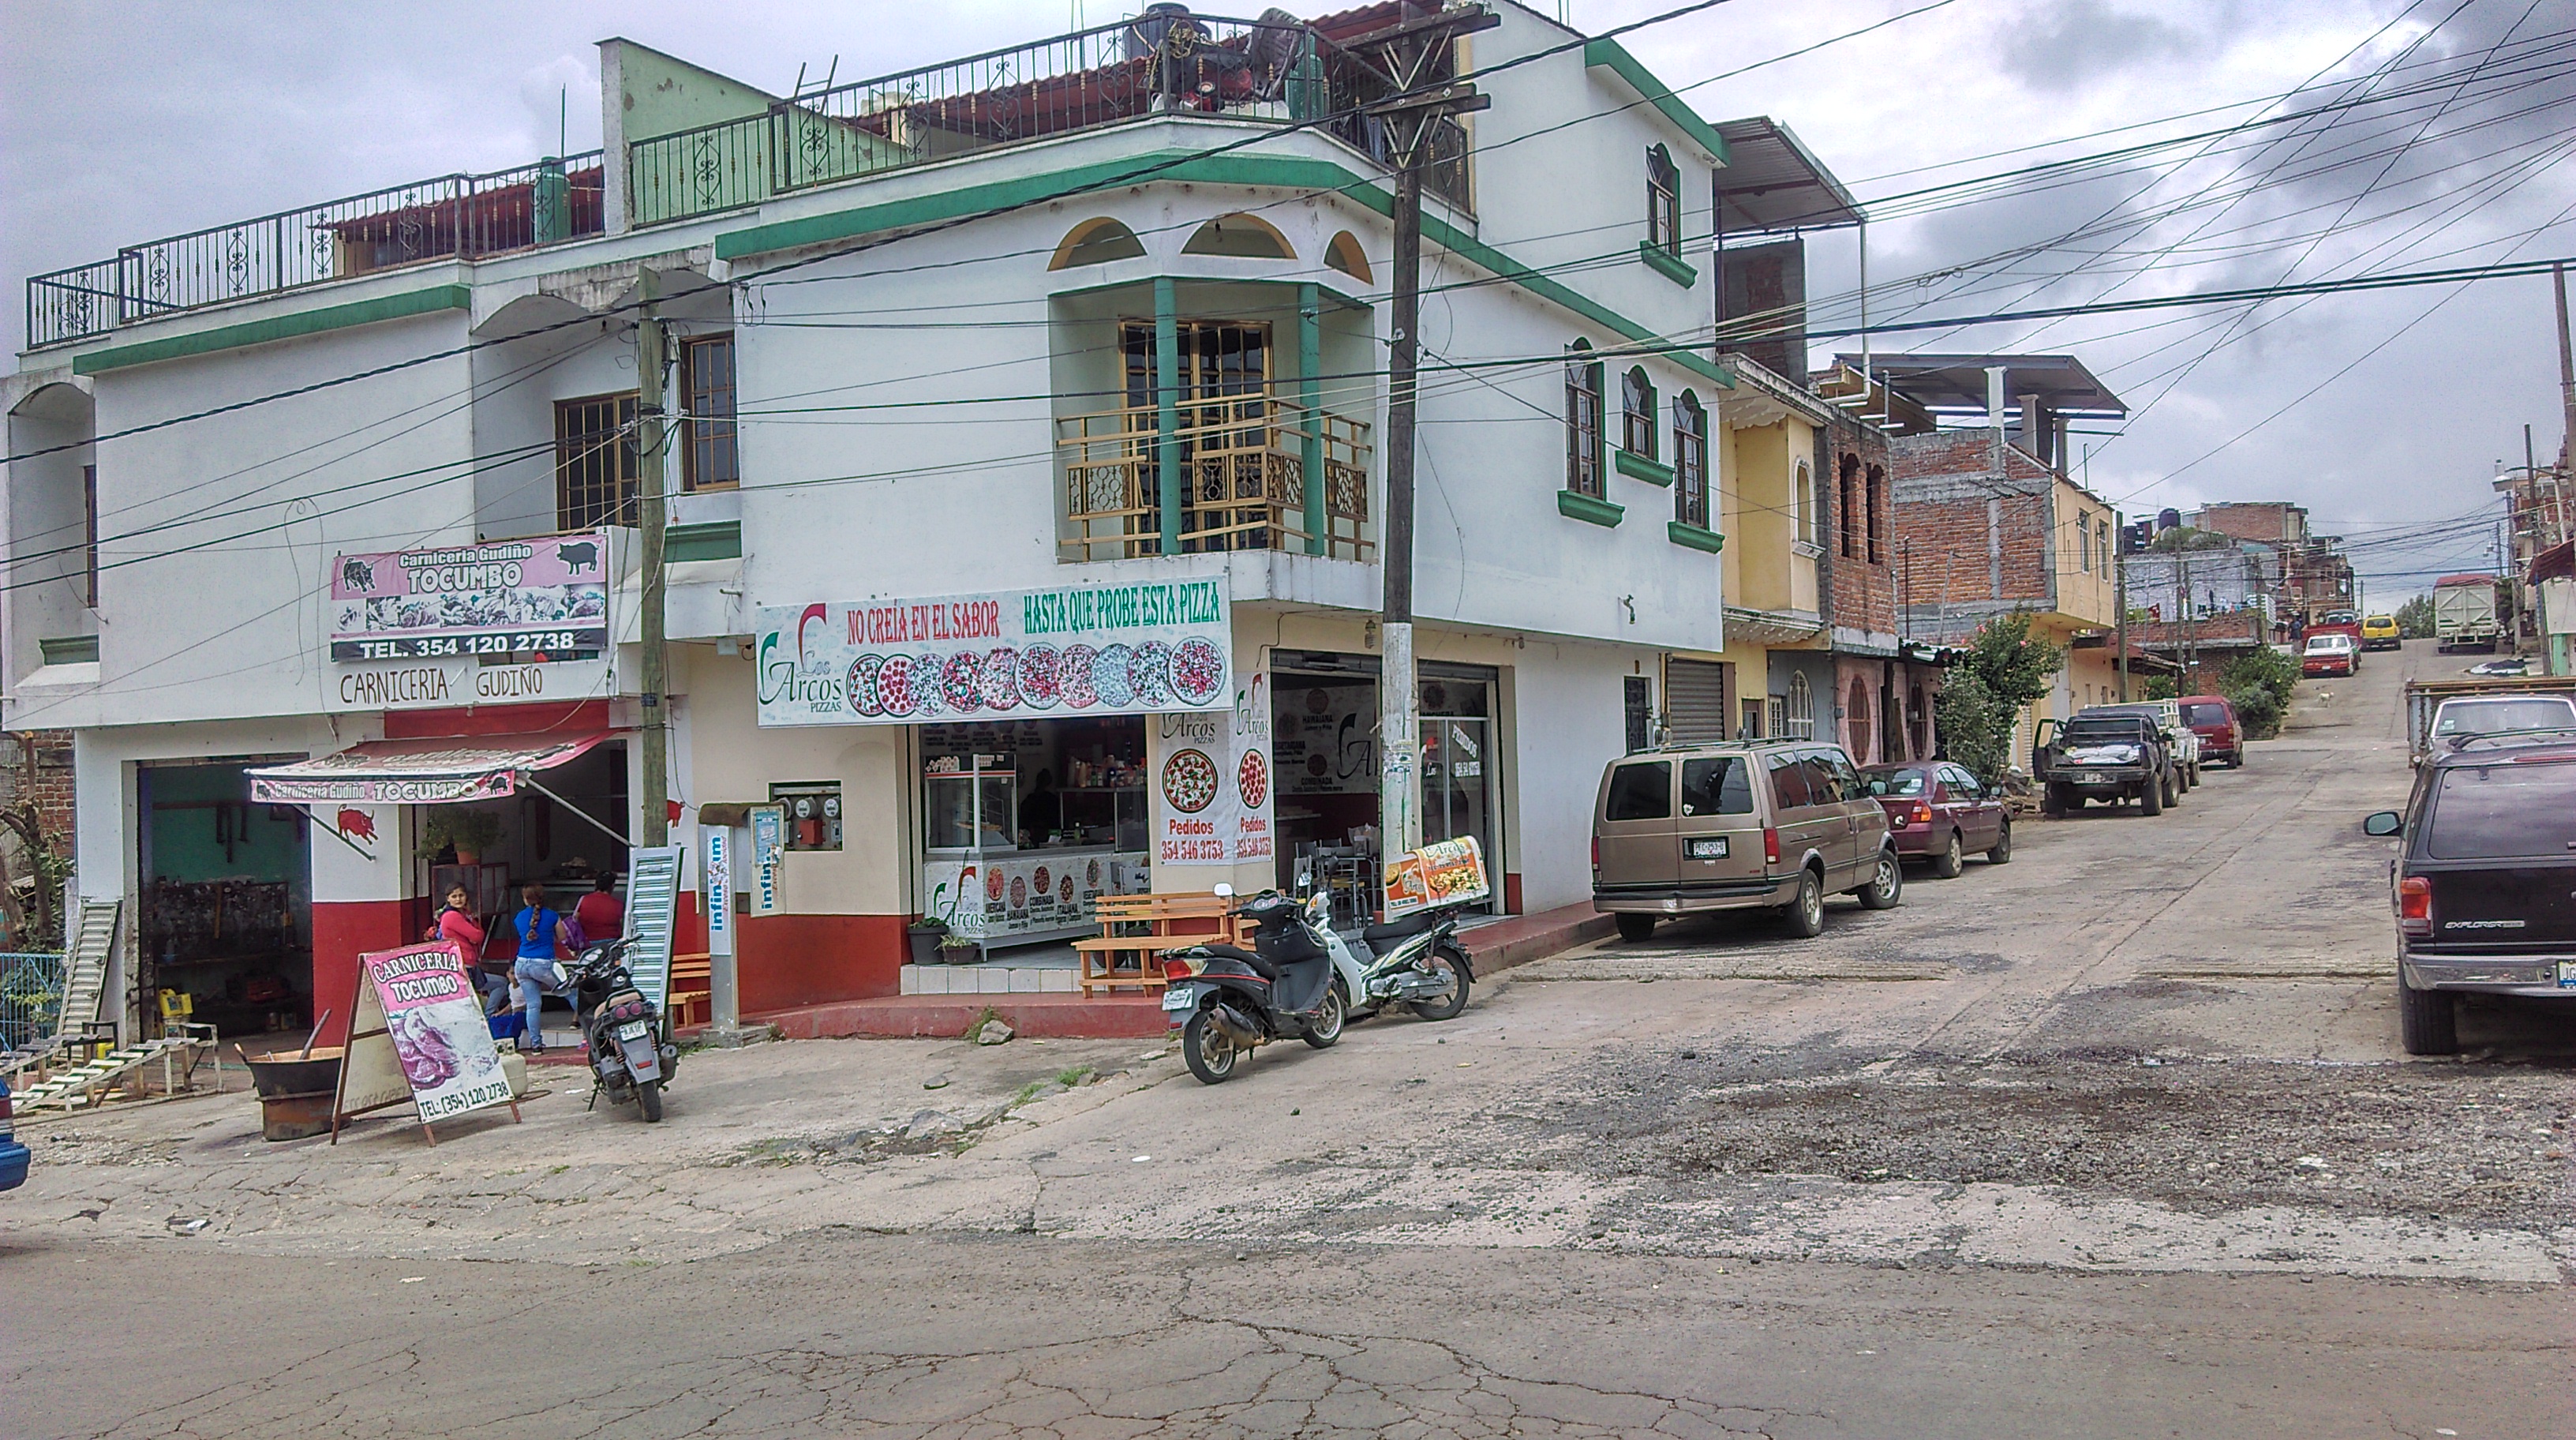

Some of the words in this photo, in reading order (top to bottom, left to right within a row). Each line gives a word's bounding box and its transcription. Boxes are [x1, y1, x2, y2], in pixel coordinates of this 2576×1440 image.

[400, 550, 475, 567] Carniceria
[479, 546, 532, 561] Gudiño
[408, 562, 522, 593] TOCUMBO
[1024, 593, 1067, 634] HASTA
[1069, 591, 1095, 634] QUE
[1097, 587, 1139, 631] PROBE
[1143, 584, 1177, 625] ESTA
[1180, 582, 1220, 623] PIZZA
[848, 609, 864, 645] NO
[868, 598, 908, 645] CREÍA
[912, 606, 928, 641] EN
[932, 604, 949, 639] EL
[953, 600, 1000, 639] SABOR
[360, 642, 409, 658] TEL.
[416, 638, 458, 657] 354
[466, 636, 507, 653] 120
[515, 632, 575, 651] 2738
[796, 651, 830, 677] Los
[340, 668, 448, 703] CARNICERIA
[476, 666, 542, 696] GUDIÑO
[759, 662, 842, 705] Arcos
[811, 701, 841, 712] PIZZAS
[1162, 713, 1215, 739] Arcos
[1237, 709, 1268, 735] Arcos
[1451, 724, 1478, 759] PEDIDOS
[275, 782, 327, 799] Carniceria
[329, 782, 365, 799] Gudiño
[375, 780, 480, 801] TOCUMBO
[1170, 819, 1214, 834] Pedidos
[1241, 816, 1266, 833] Pedidos
[1162, 840, 1179, 860] 354
[1181, 840, 1197, 860] 546
[1200, 839, 1223, 859] 3753
[939, 901, 985, 927] Arcos
[2445, 921, 2503, 929] EXPLORER
[373, 951, 459, 983] CARNICERIA
[390, 974, 459, 1002] TOCUMBO
[419, 1100, 441, 1117] TEL:
[440, 1092, 470, 1114] (354)
[469, 1087, 486, 1104] 120
[485, 1081, 509, 1100] 2738
